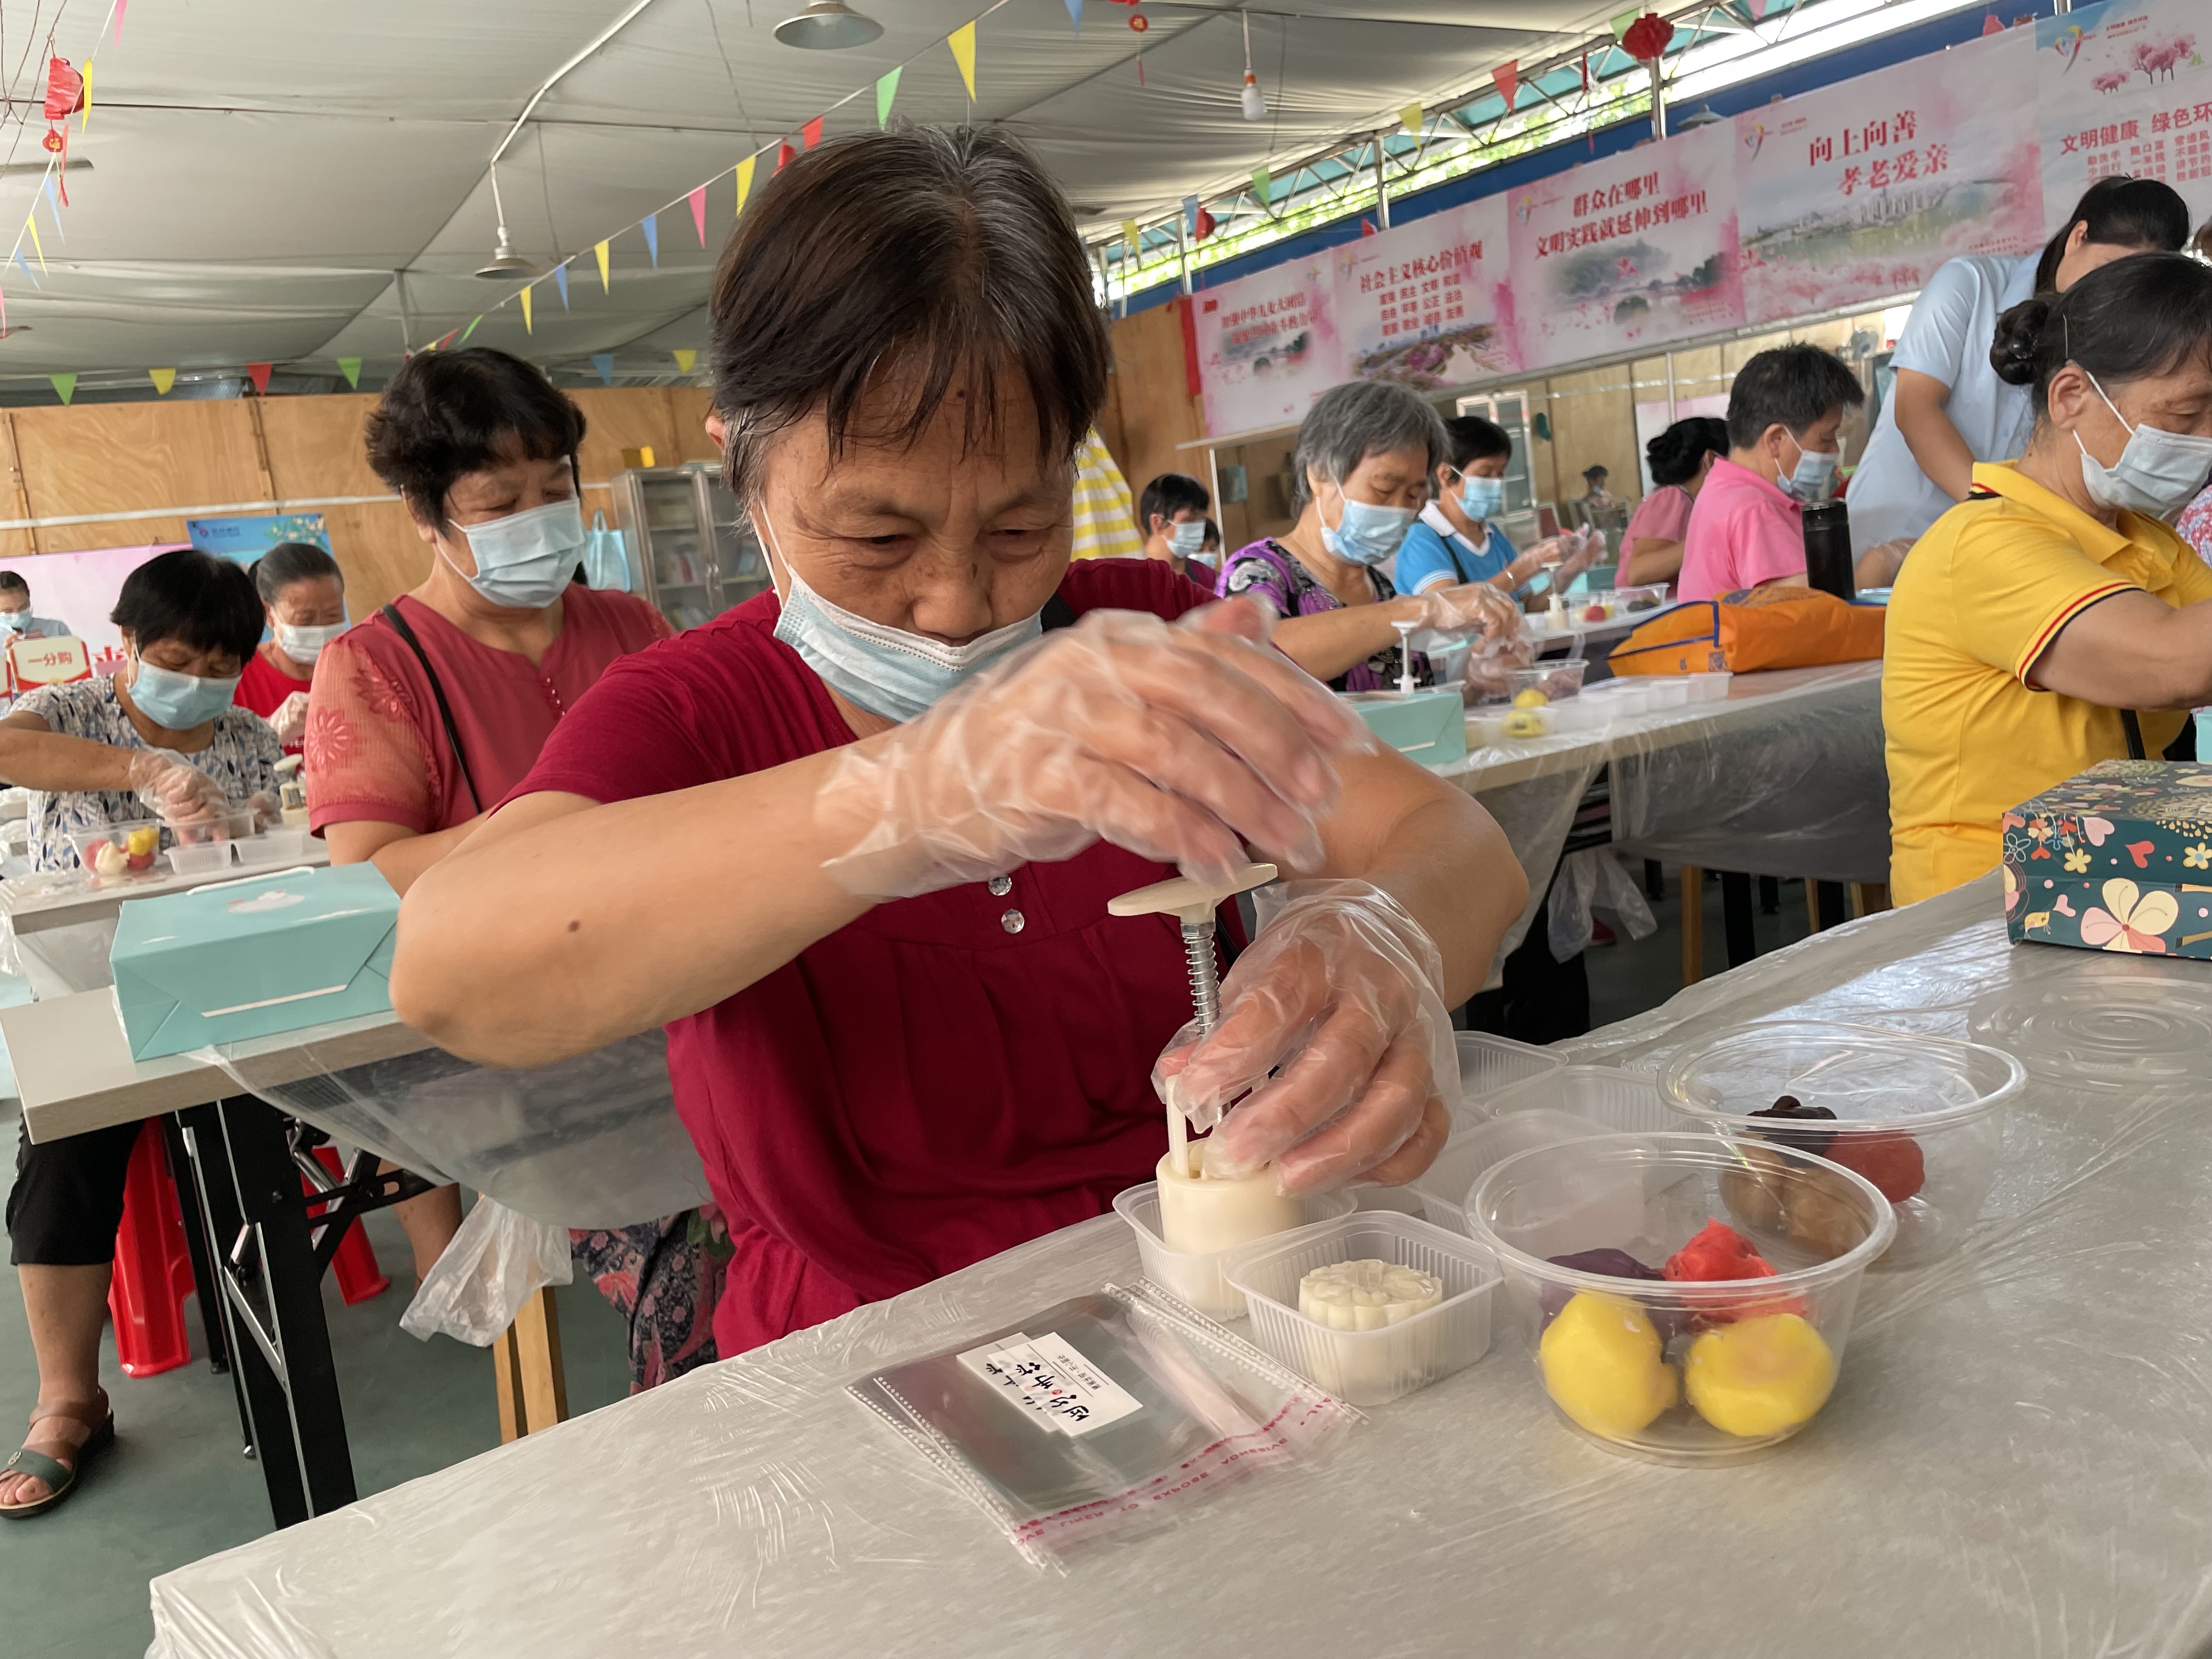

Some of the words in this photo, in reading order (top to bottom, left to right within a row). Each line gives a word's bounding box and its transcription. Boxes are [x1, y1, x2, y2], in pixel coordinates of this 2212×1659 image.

[1810, 110, 1917, 166] 向上向善
[2061, 120, 2139, 155] 文明健康
[1573, 171, 1661, 219] 群众在哪里
[1838, 143, 1948, 196] 孝老爱亲
[1536, 189, 1709, 260] 文明实践就延伸到哪里
[1360, 240, 1483, 294] 社会主义核心价值观
[28, 651, 72, 667] 一分购
